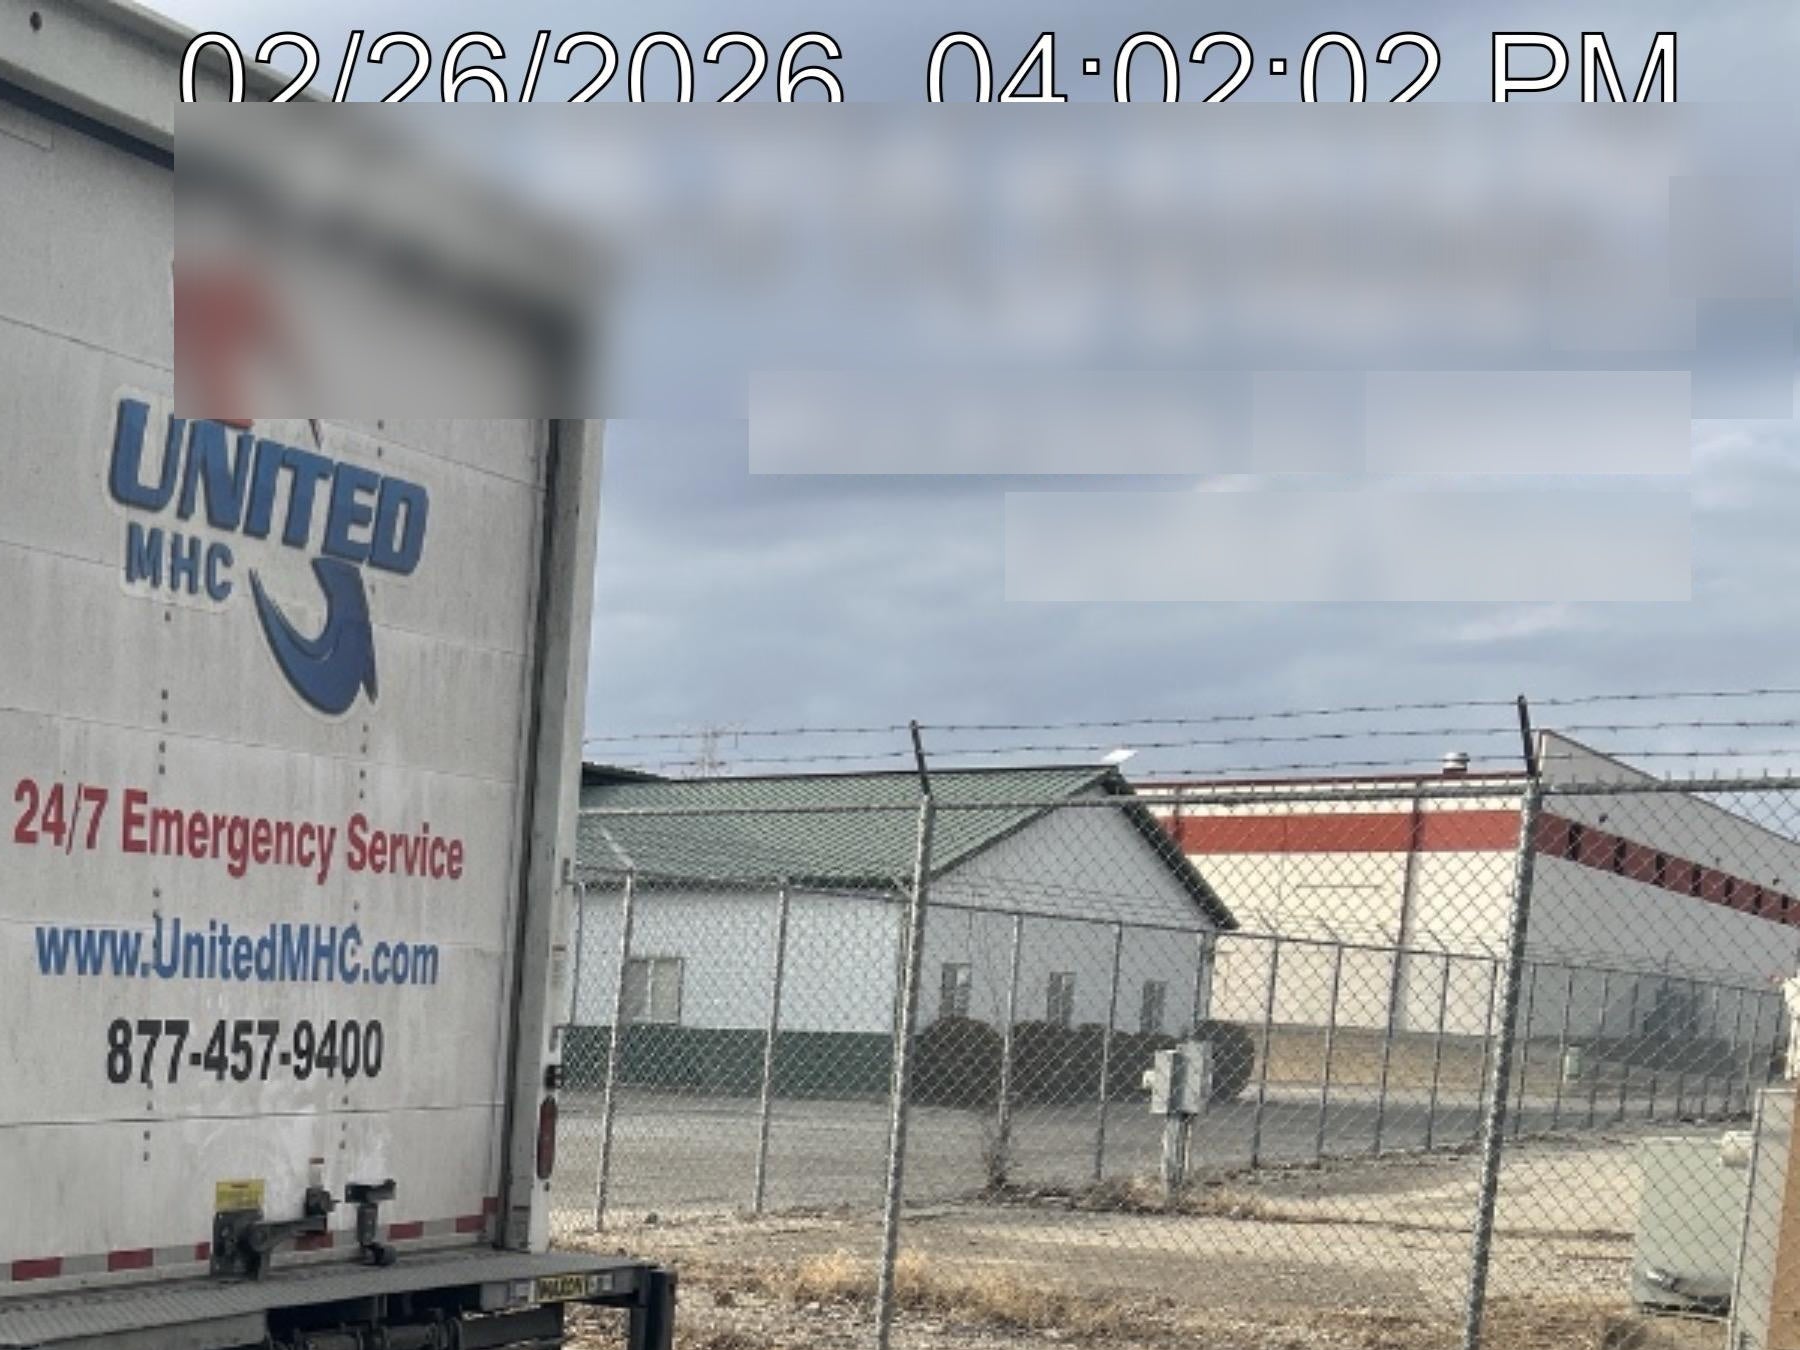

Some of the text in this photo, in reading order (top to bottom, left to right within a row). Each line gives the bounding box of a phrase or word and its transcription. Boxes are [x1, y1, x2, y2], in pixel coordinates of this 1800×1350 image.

[108, 397, 430, 577] UNITED
[125, 521, 234, 602] MHC
[13, 778, 464, 886] 24/7 Emergency Service
[35, 917, 439, 986] www.UnitedMHC.com
[106, 1018, 385, 1085] 877-457-9400
